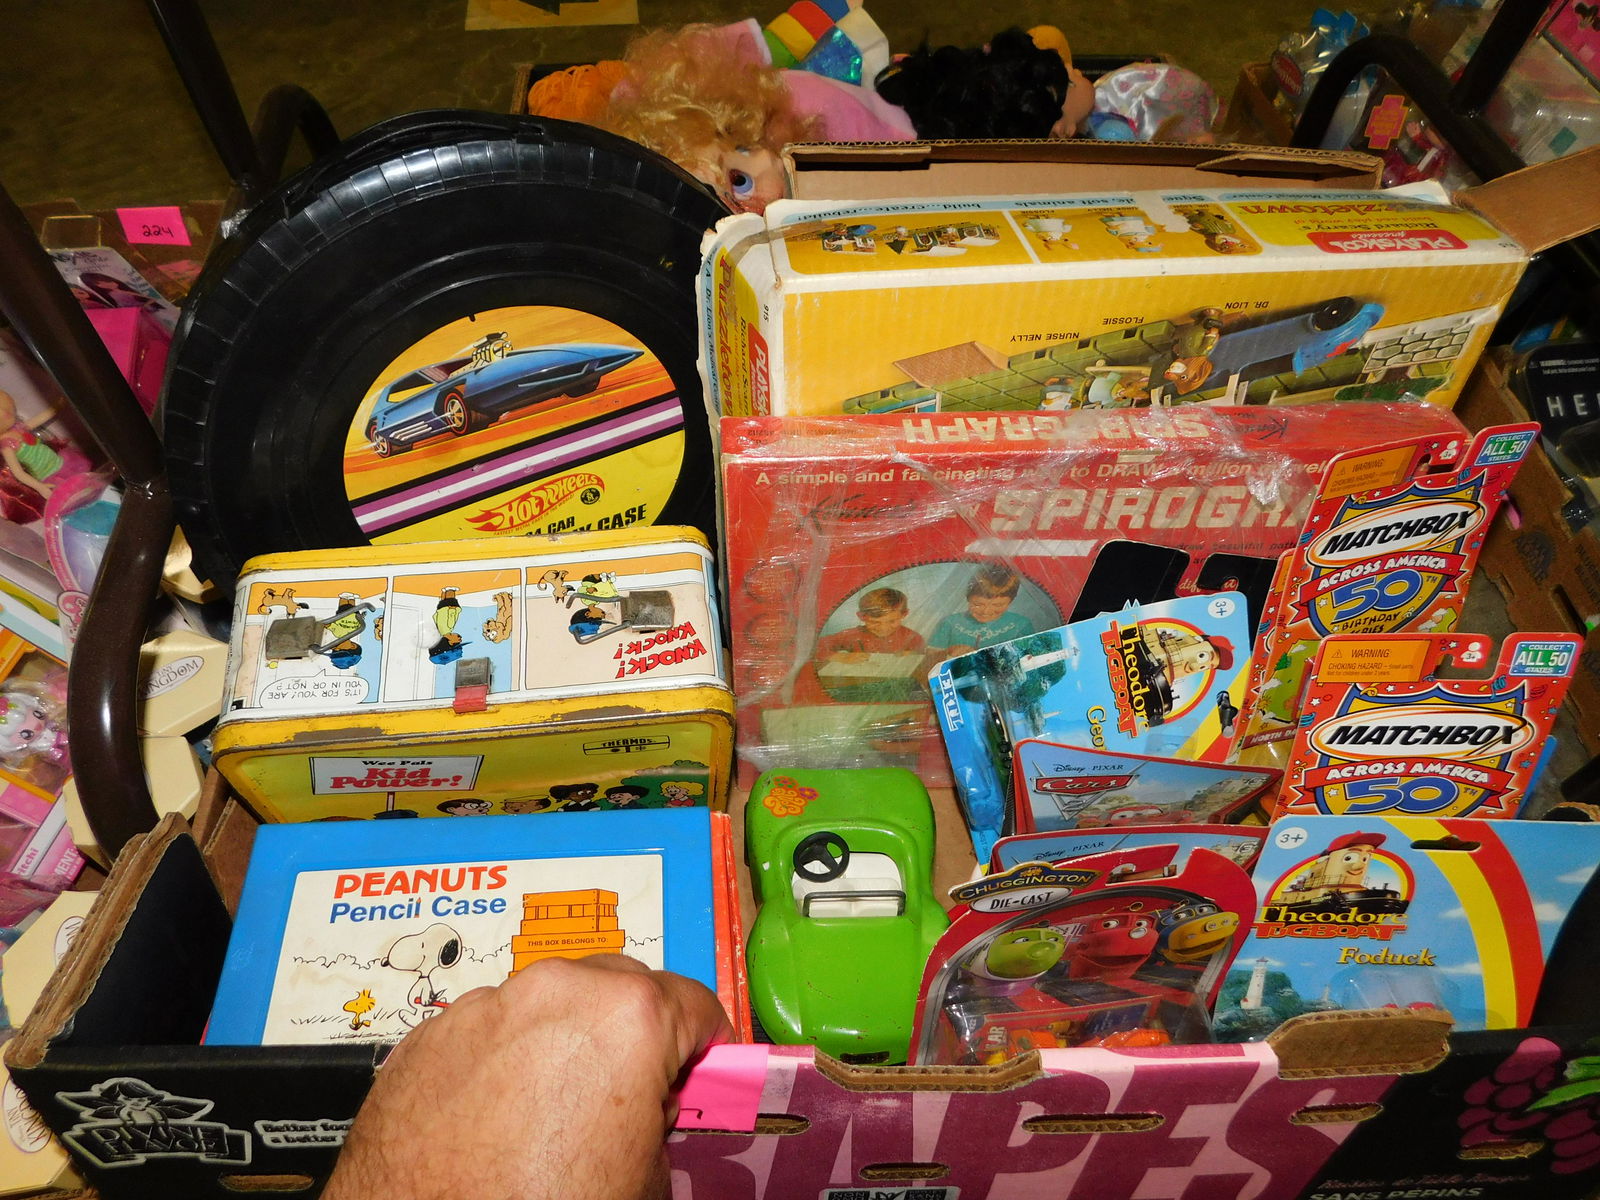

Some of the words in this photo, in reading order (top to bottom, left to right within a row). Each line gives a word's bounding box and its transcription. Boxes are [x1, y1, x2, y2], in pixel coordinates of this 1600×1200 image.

[1014, 199, 1076, 208] animals
[142, 225, 174, 238] 224
[1376, 222, 1439, 230] Richard
[1328, 237, 1454, 253] PLAYSKOOL
[1224, 301, 1249, 310] LION
[1253, 300, 1270, 310] DR.
[1102, 316, 1145, 326] FLOSSIE
[740, 316, 749, 371] Richard
[1010, 333, 1042, 343] NELLY
[1045, 332, 1080, 342] NURSE
[1546, 392, 1600, 417] HE
[1494, 433, 1526, 443] COLLECT
[1483, 441, 1509, 457] ALL
[1510, 439, 1527, 454] 50
[1487, 454, 1513, 463] STATES
[755, 473, 771, 486] A
[778, 470, 848, 487] simple
[855, 468, 894, 483] and
[901, 465, 1016, 484] fascinating
[1070, 464, 1091, 478] to
[1097, 463, 1166, 479] DRAW
[547, 516, 576, 534] CAR
[598, 503, 648, 531] CASE
[1320, 507, 1477, 557] MATCHBOX
[1317, 560, 1381, 592] ACROSS
[1383, 554, 1447, 571] AMERICA
[1331, 569, 1424, 622] 50
[1215, 600, 1228, 617] 3+
[1341, 611, 1401, 631] BIRTHDAY
[613, 621, 697, 660] KNOCK!
[1528, 644, 1564, 652] COLLECT
[614, 638, 708, 679] KNOCK!
[1328, 662, 1356, 671] CHOKING
[1357, 662, 1383, 670] HAZARD
[1515, 651, 1546, 667] ALL
[1547, 651, 1569, 667] 50
[1118, 614, 1151, 732] Theodore
[313, 682, 328, 690] OR
[345, 689, 361, 697] IT'S
[346, 681, 362, 689] YOU
[267, 692, 289, 700] ARE
[290, 691, 317, 699] YOU!
[321, 690, 339, 698] FOR
[940, 669, 964, 732] ERTL
[1087, 704, 1107, 752] Geo
[1326, 724, 1515, 747] MATCHBOX
[1250, 733, 1282, 745] NORTH
[399, 759, 433, 767] Pals
[1053, 764, 1086, 774] Disney
[1092, 763, 1125, 772] PIXAR
[364, 767, 432, 780] Kid
[1325, 762, 1407, 782] ACROSS
[1413, 762, 1490, 784] AMERICA
[330, 775, 463, 790] Power!
[1042, 777, 1120, 792] Cars
[1345, 776, 1461, 814] 50
[1280, 832, 1305, 844] 3+
[1033, 848, 1067, 862] Disney
[1071, 841, 1105, 852] PIXAR
[333, 865, 509, 899] PEANUTS
[957, 873, 1093, 902] CHUGGINGTON
[990, 890, 1055, 911] DIE-CAST
[329, 895, 422, 925] Pencil
[431, 894, 507, 918] Case
[1256, 905, 1409, 925] Theodore
[1336, 946, 1438, 966] Foduck
[262, 1122, 318, 1133] Better
[283, 1134, 338, 1144] better
